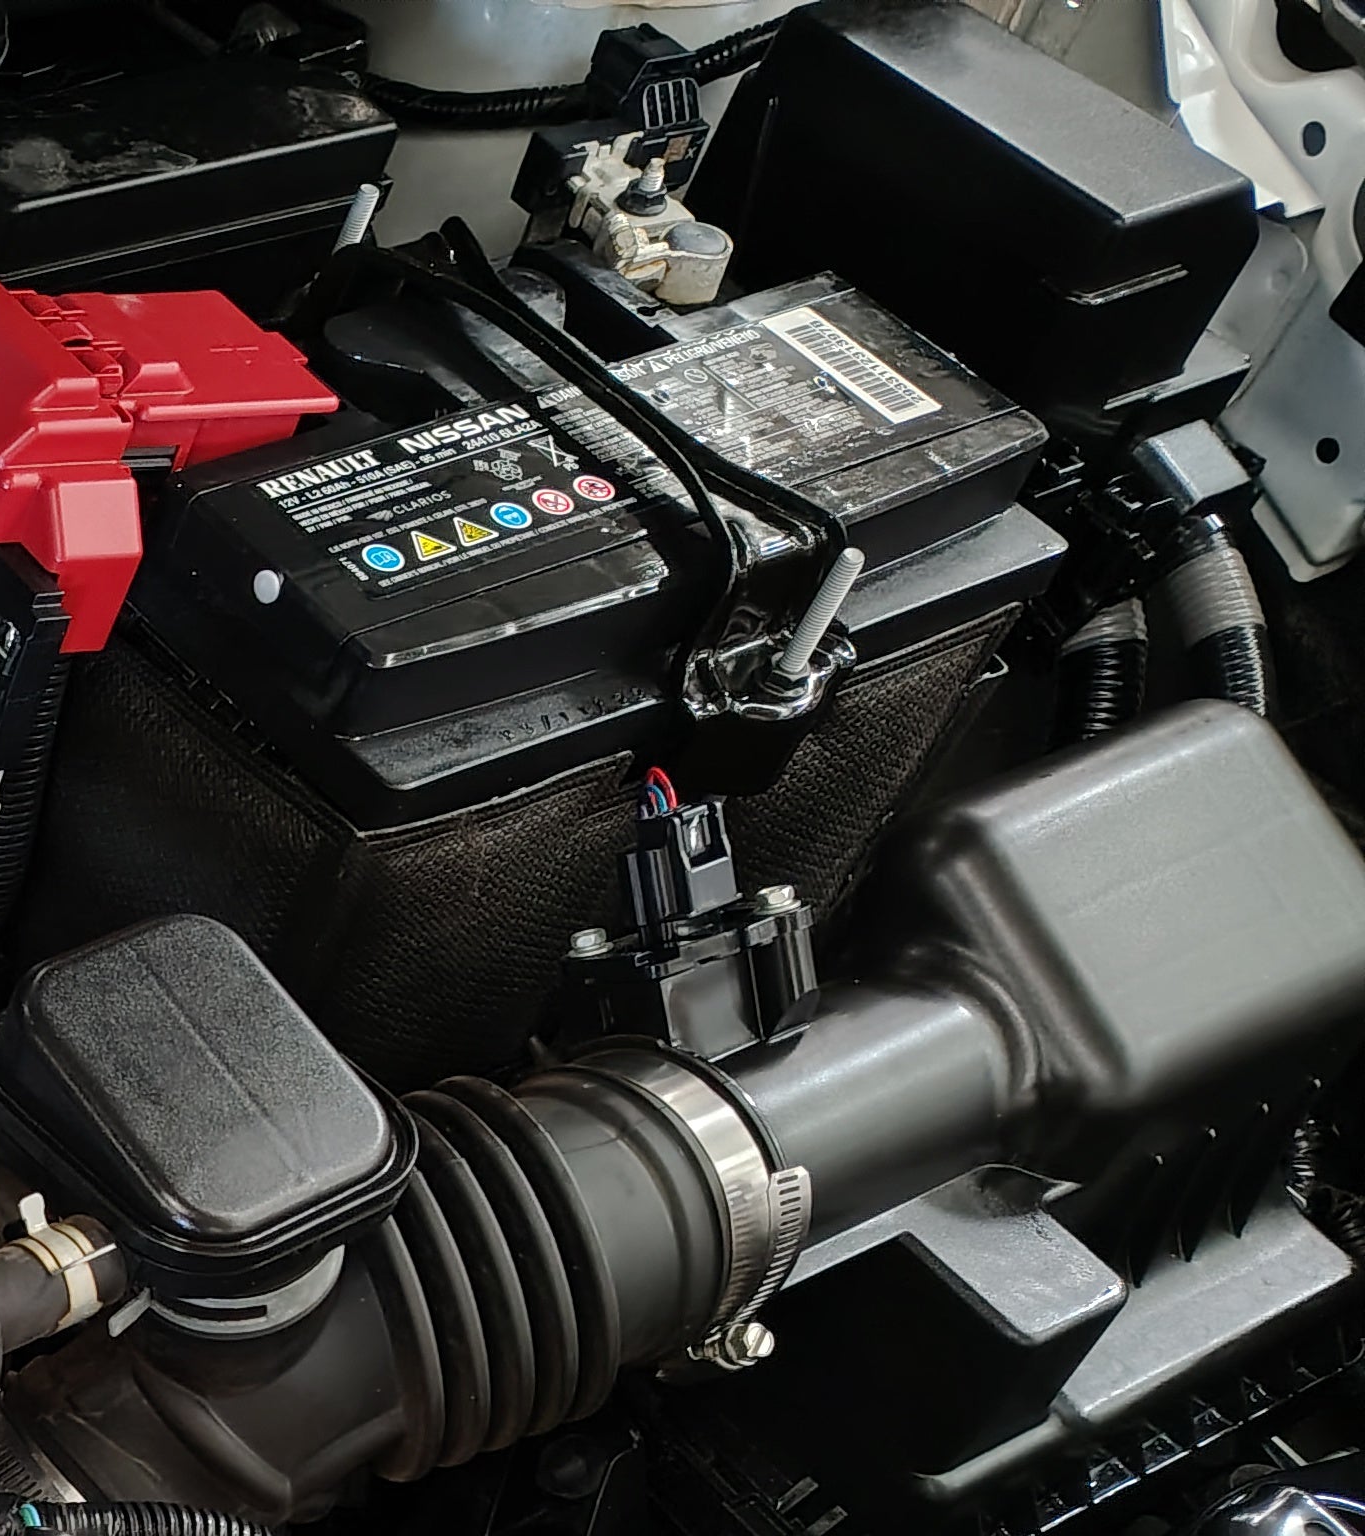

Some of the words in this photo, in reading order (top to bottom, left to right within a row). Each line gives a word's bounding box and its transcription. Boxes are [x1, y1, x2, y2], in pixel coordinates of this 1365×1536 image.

[397, 403, 531, 455] NISSAN
[461, 432, 500, 452] 24410
[500, 418, 544, 441] 6LA2A
[257, 450, 382, 498] RENAULT
[278, 491, 302, 511] 12V
[307, 486, 320, 502] L2
[357, 468, 385, 487] 510A
[382, 459, 415, 481] (SAE)
[435, 447, 457, 461] min
[393, 490, 453, 517] CLARIOS
